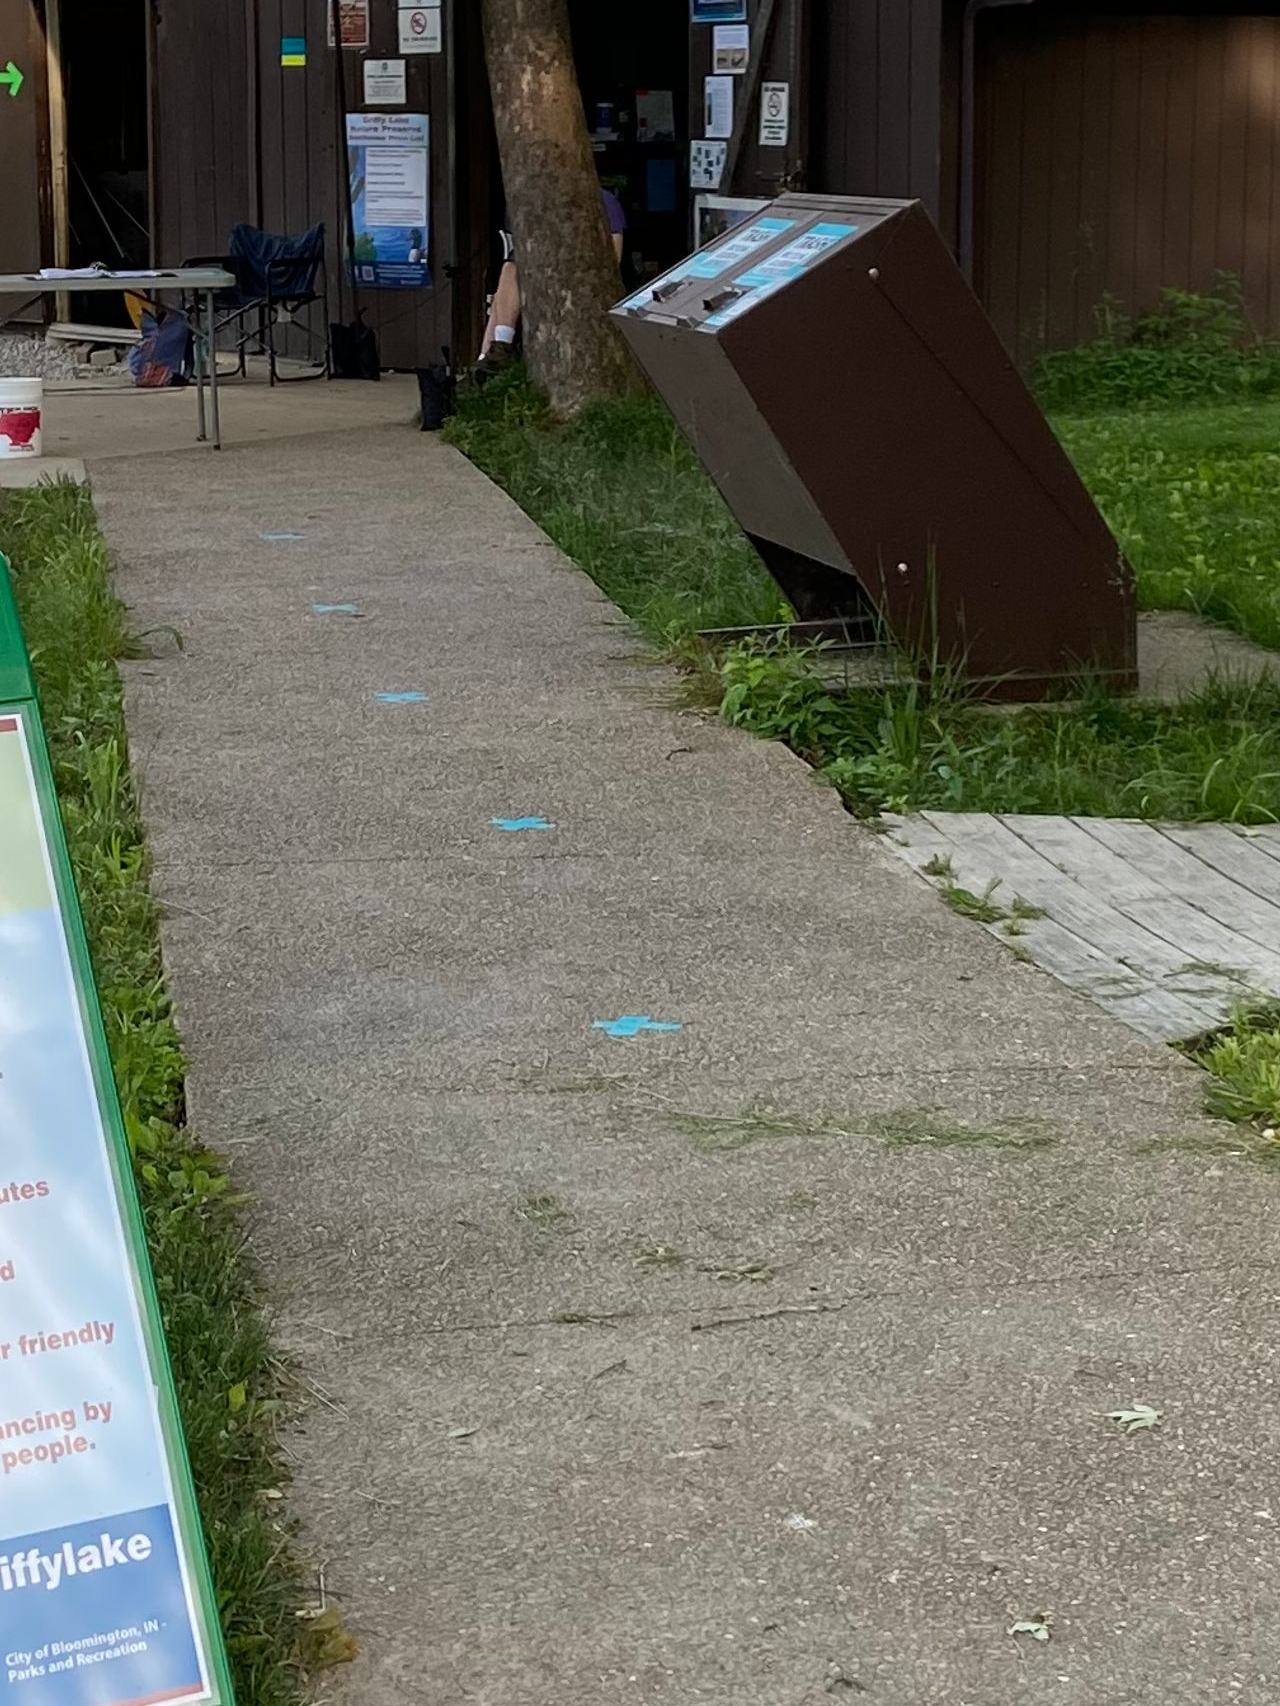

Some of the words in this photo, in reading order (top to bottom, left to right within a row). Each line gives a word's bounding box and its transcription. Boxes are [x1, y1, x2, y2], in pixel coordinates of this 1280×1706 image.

[18, 1320, 114, 1355] friendly
[82, 1401, 112, 1424] by
[1, 1434, 96, 1474] people.
[5, 1652, 32, 1666] City
[34, 1644, 48, 1659] of
[51, 1627, 141, 1656] Bloomington,
[143, 1619, 158, 1633] IN
[8, 1664, 45, 1682] Parks
[48, 1655, 74, 1672] and
[76, 1641, 147, 1666] Recreation
